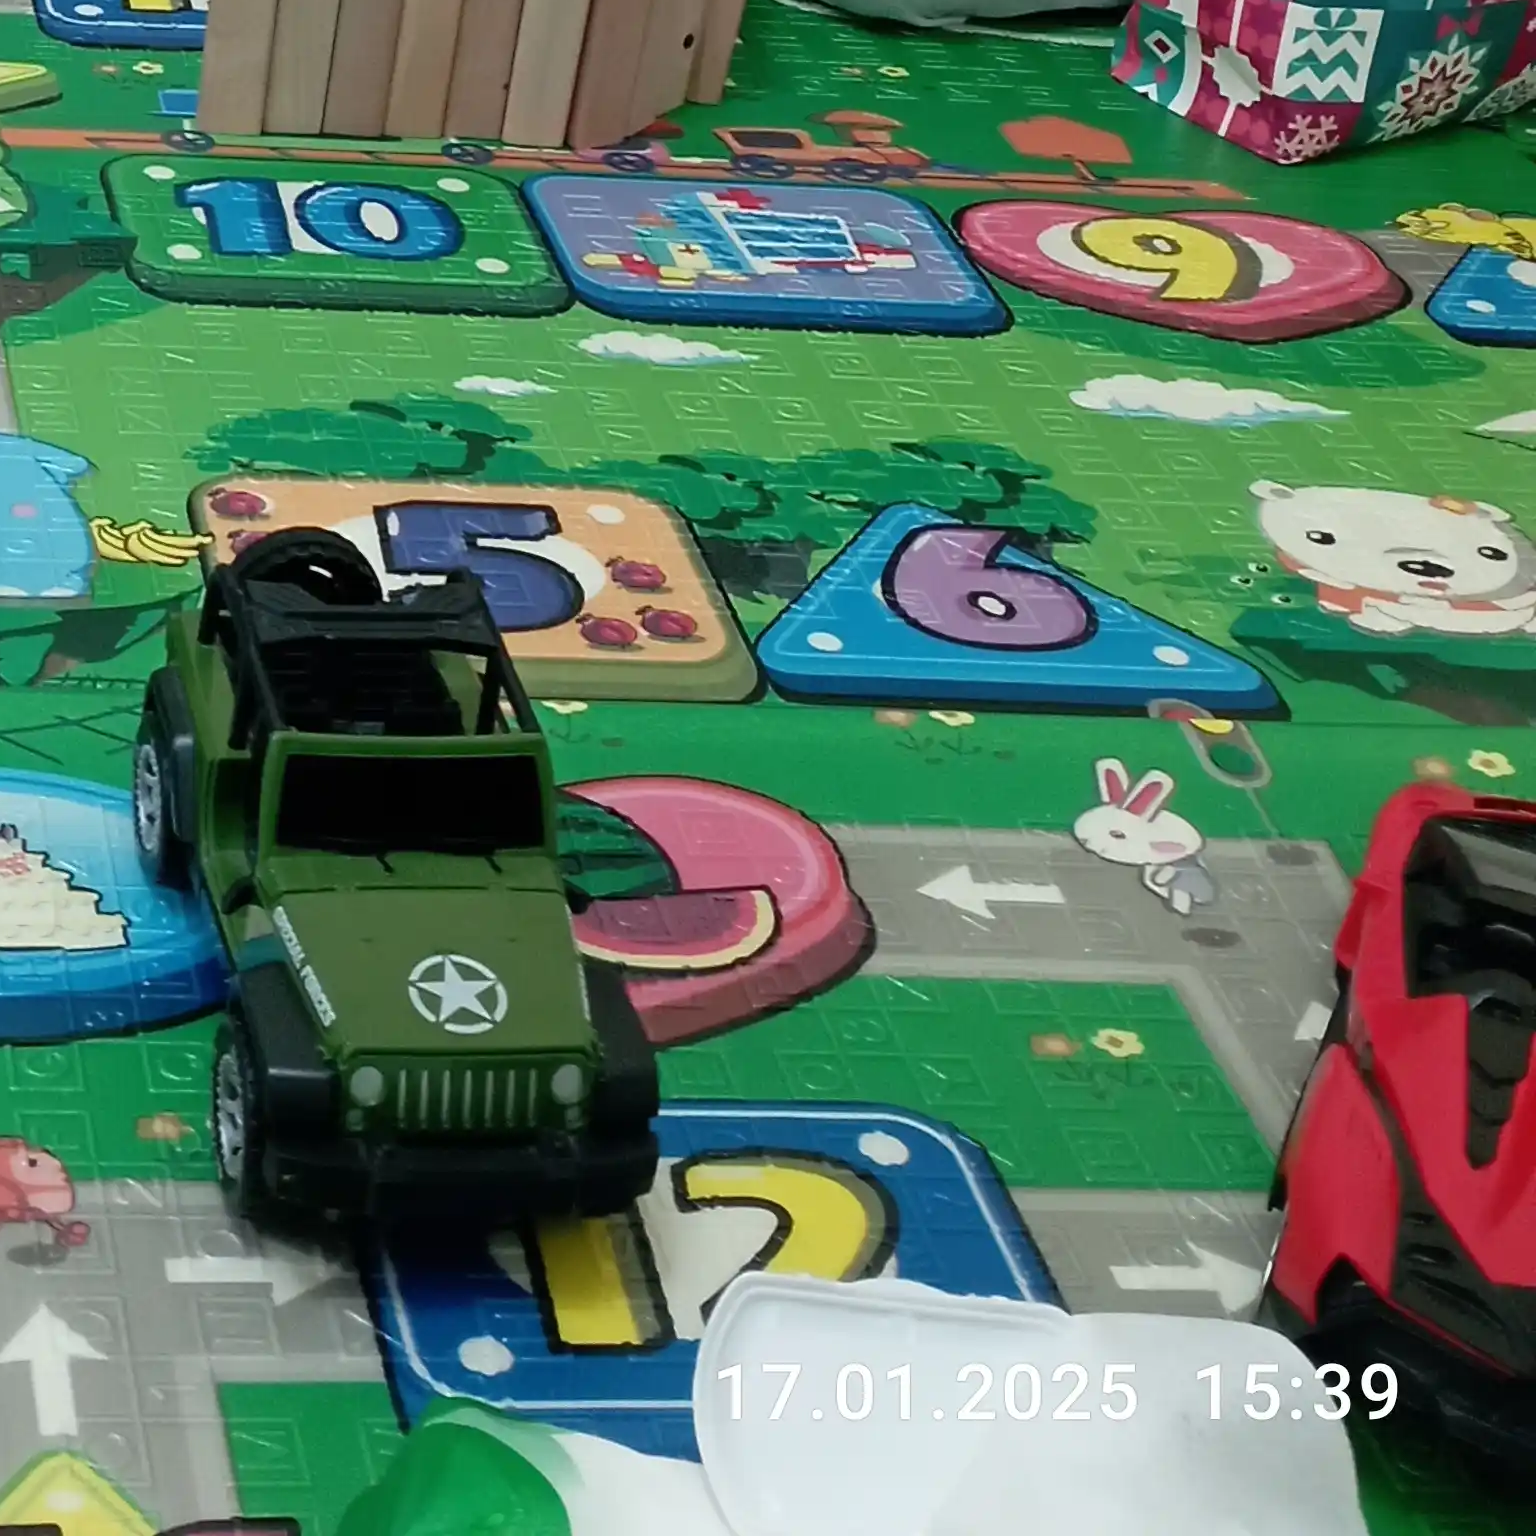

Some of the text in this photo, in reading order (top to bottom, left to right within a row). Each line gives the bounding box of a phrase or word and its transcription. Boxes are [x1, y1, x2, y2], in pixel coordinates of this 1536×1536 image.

[173, 176, 465, 260] 10
[1070, 216, 1264, 303] 9
[372, 500, 584, 631] 5
[881, 523, 1099, 650] 6
